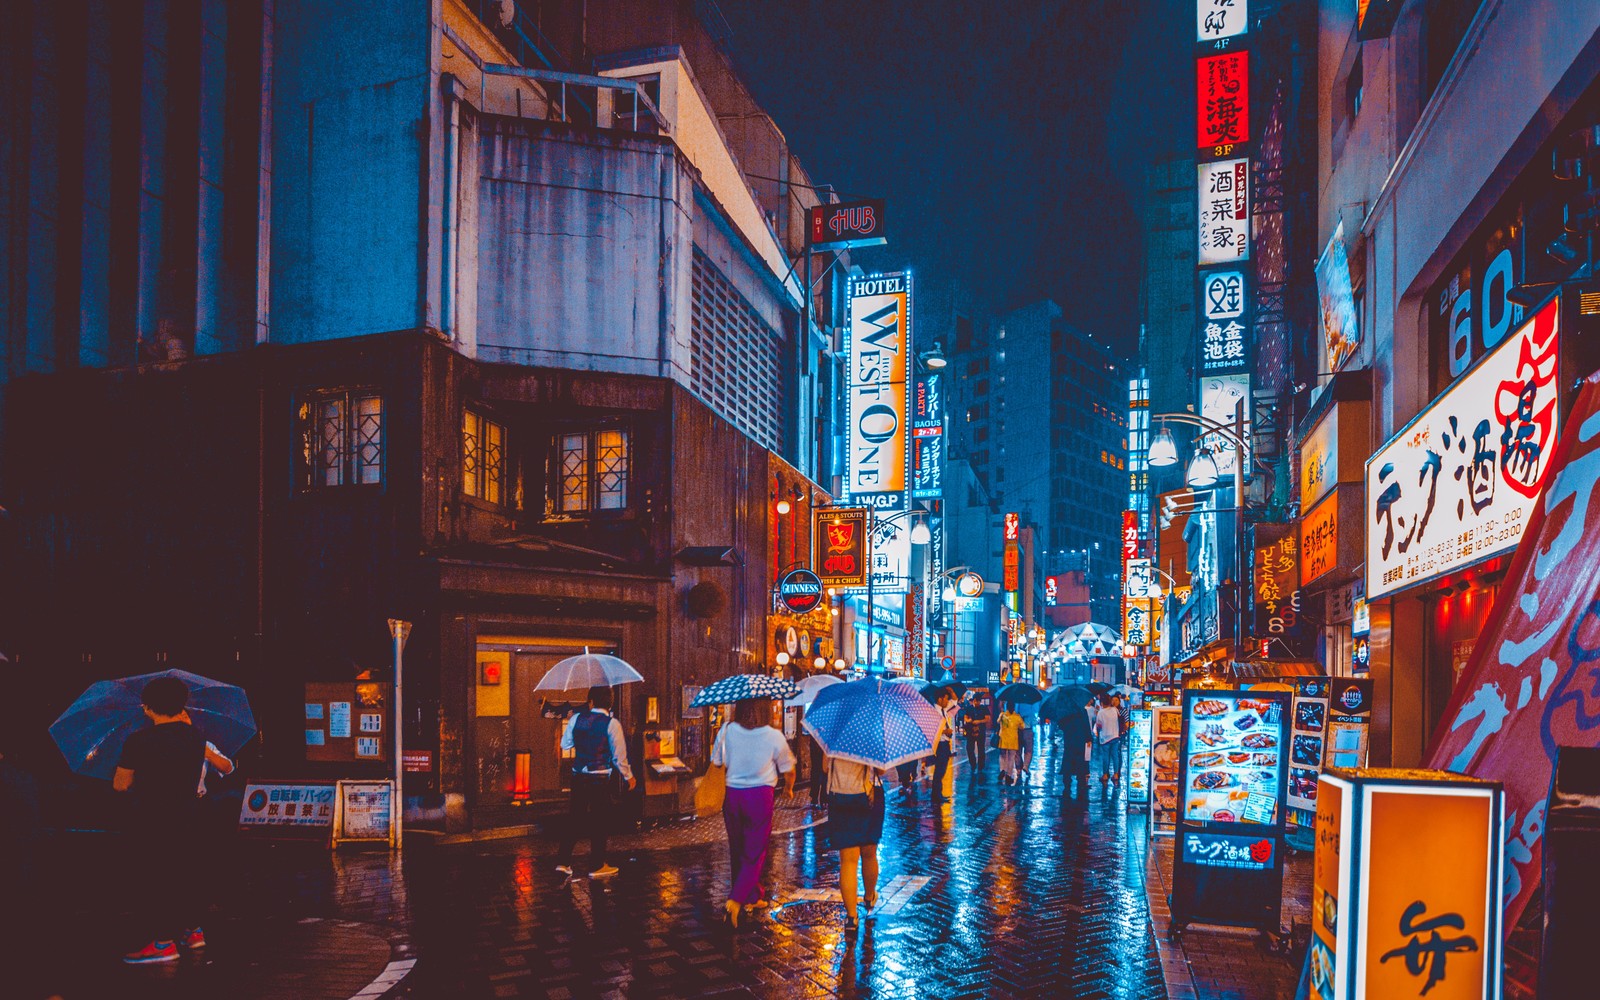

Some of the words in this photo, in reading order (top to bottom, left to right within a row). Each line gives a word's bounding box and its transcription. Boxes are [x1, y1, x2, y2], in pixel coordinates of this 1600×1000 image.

[1214, 39, 1230, 49] 4F
[1214, 145, 1234, 156] 3F
[829, 206, 876, 236] HUB
[1210, 170, 1234, 249] 酒菜家
[1237, 233, 1246, 257] 2F
[854, 278, 905, 296] HOTEL
[859, 298, 899, 402] WEST
[1204, 341, 1245, 360] 池袋
[928, 374, 940, 420] ダーツバー
[915, 419, 941, 428] BAGUS
[857, 403, 899, 487] ONE
[931, 437, 941, 488] インターネット
[1376, 380, 1540, 561] テング酒場
[825, 555, 855, 574] HUB
[1273, 536, 1297, 574] 博多
[782, 583, 820, 594] GUINNESS
[1259, 545, 1282, 615] ひとくち餃子
[1187, 835, 1251, 861] テング酒場
